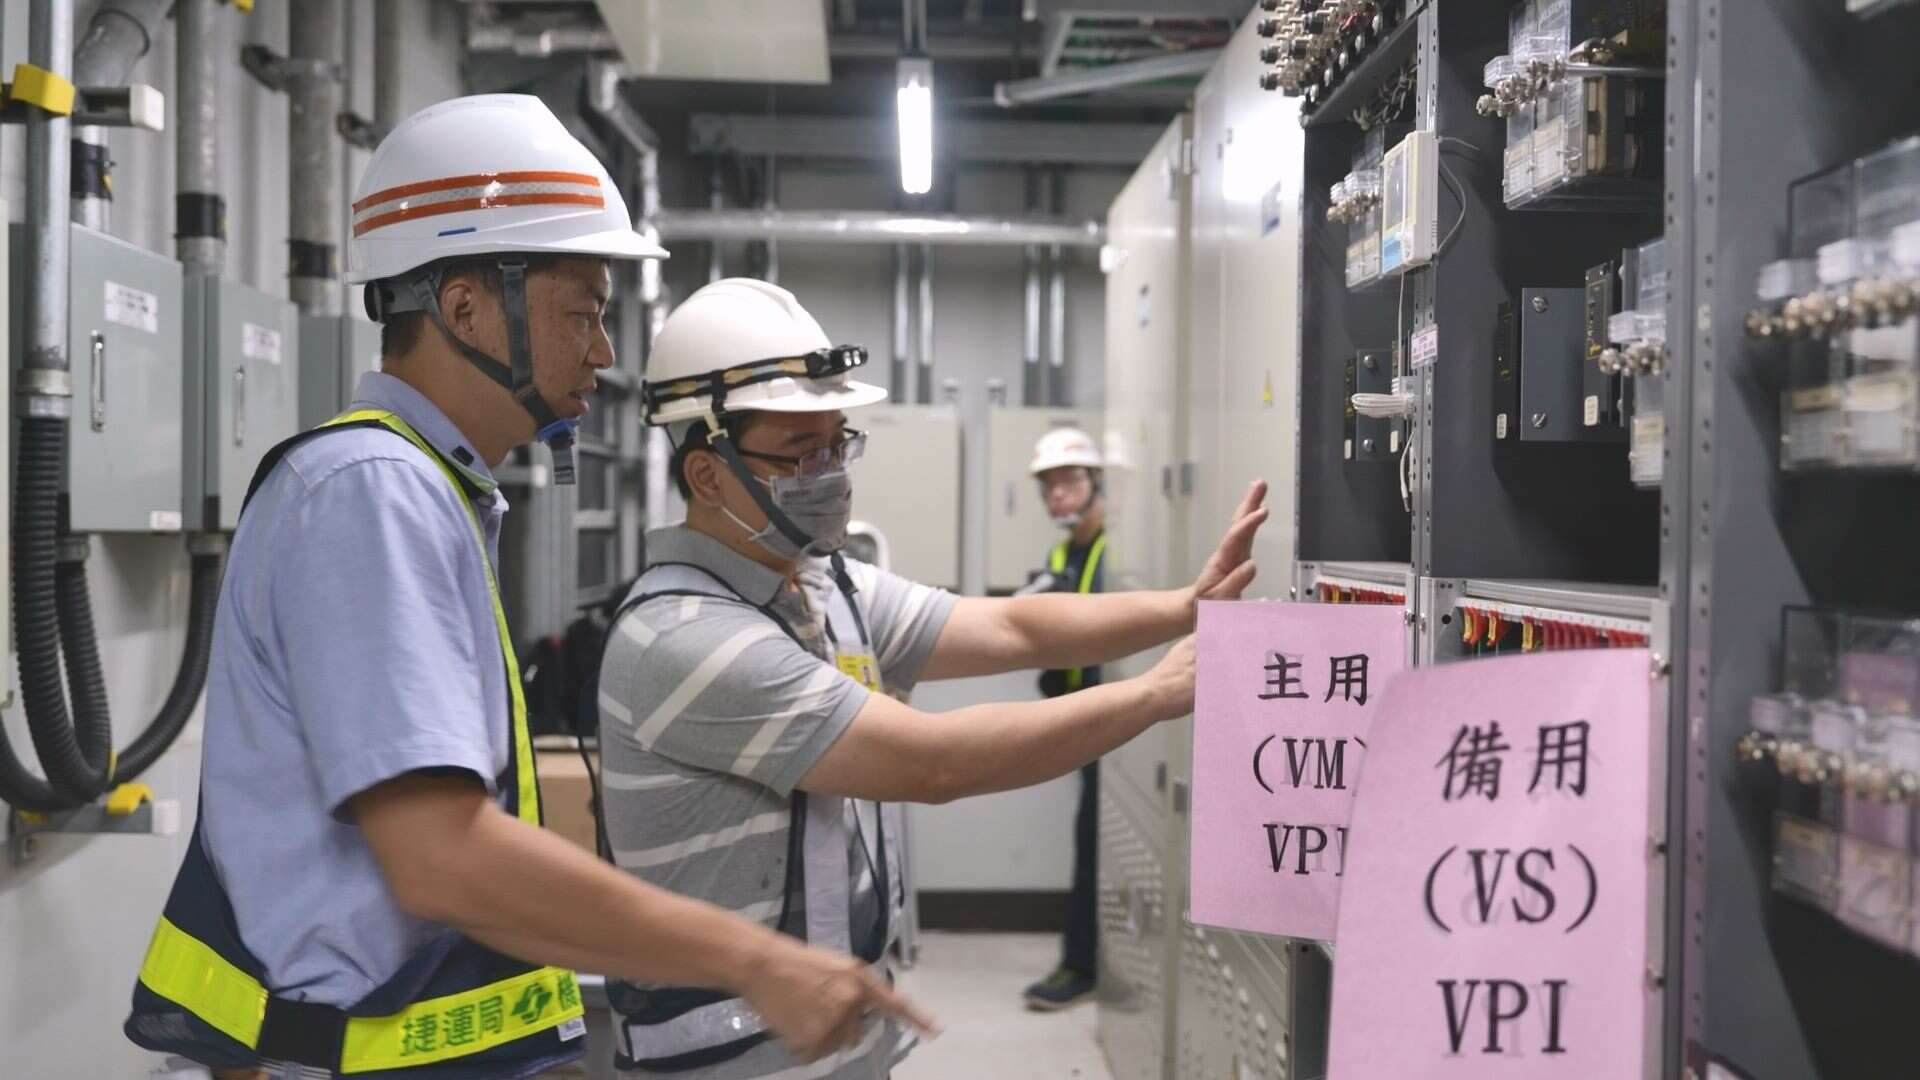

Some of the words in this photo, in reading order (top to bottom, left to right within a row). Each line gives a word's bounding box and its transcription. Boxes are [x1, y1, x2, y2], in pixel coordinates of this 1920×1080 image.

[1257, 652, 1370, 706] 主用
[1434, 719, 1592, 801] 備用
[1424, 843, 1599, 934] (VS)
[400, 995, 504, 1056] 捷運局
[1435, 979, 1568, 1054] VPI
